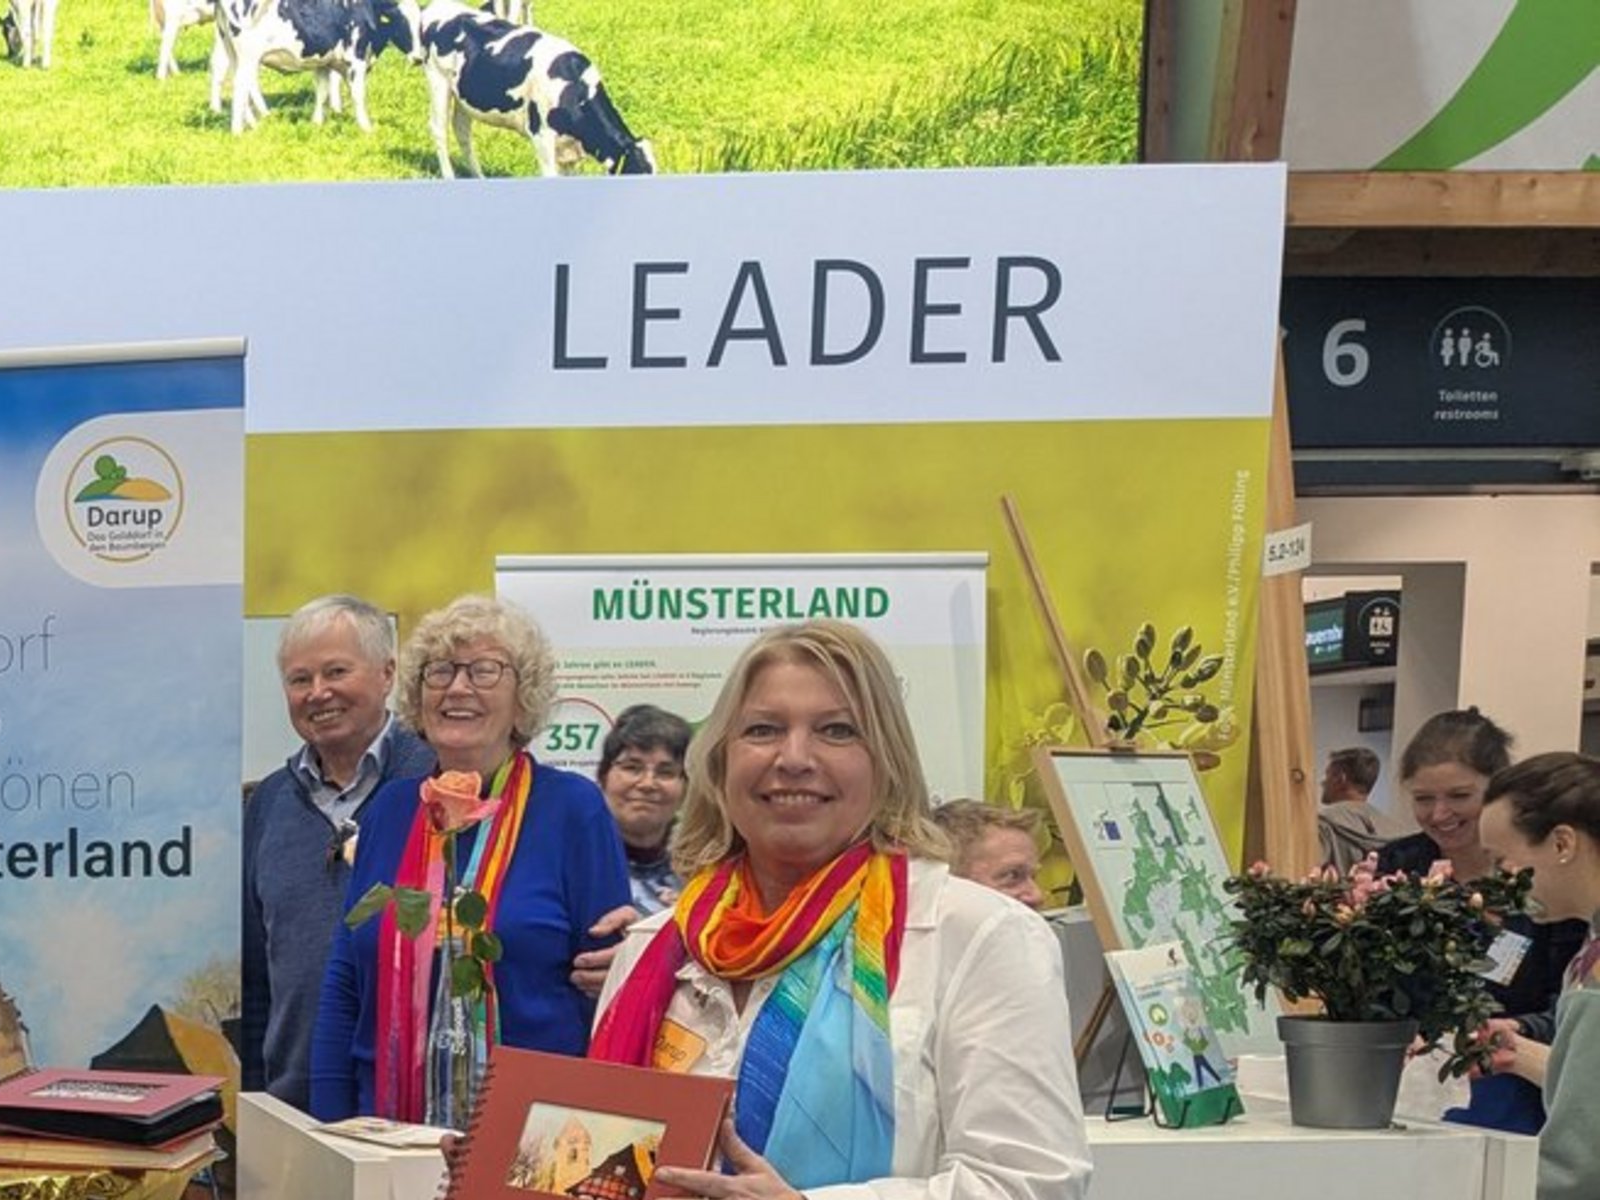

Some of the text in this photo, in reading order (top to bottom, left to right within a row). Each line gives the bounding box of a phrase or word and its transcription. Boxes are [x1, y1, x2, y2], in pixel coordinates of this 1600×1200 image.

[552, 256, 1062, 369] LEADER
[1321, 318, 1370, 387] 6
[1438, 390, 1498, 402] Toiletten
[1434, 409, 1499, 421] restrooms
[87, 506, 164, 529] Darup
[593, 579, 890, 620] MÜNSTERLAND
[546, 723, 599, 751] 357
